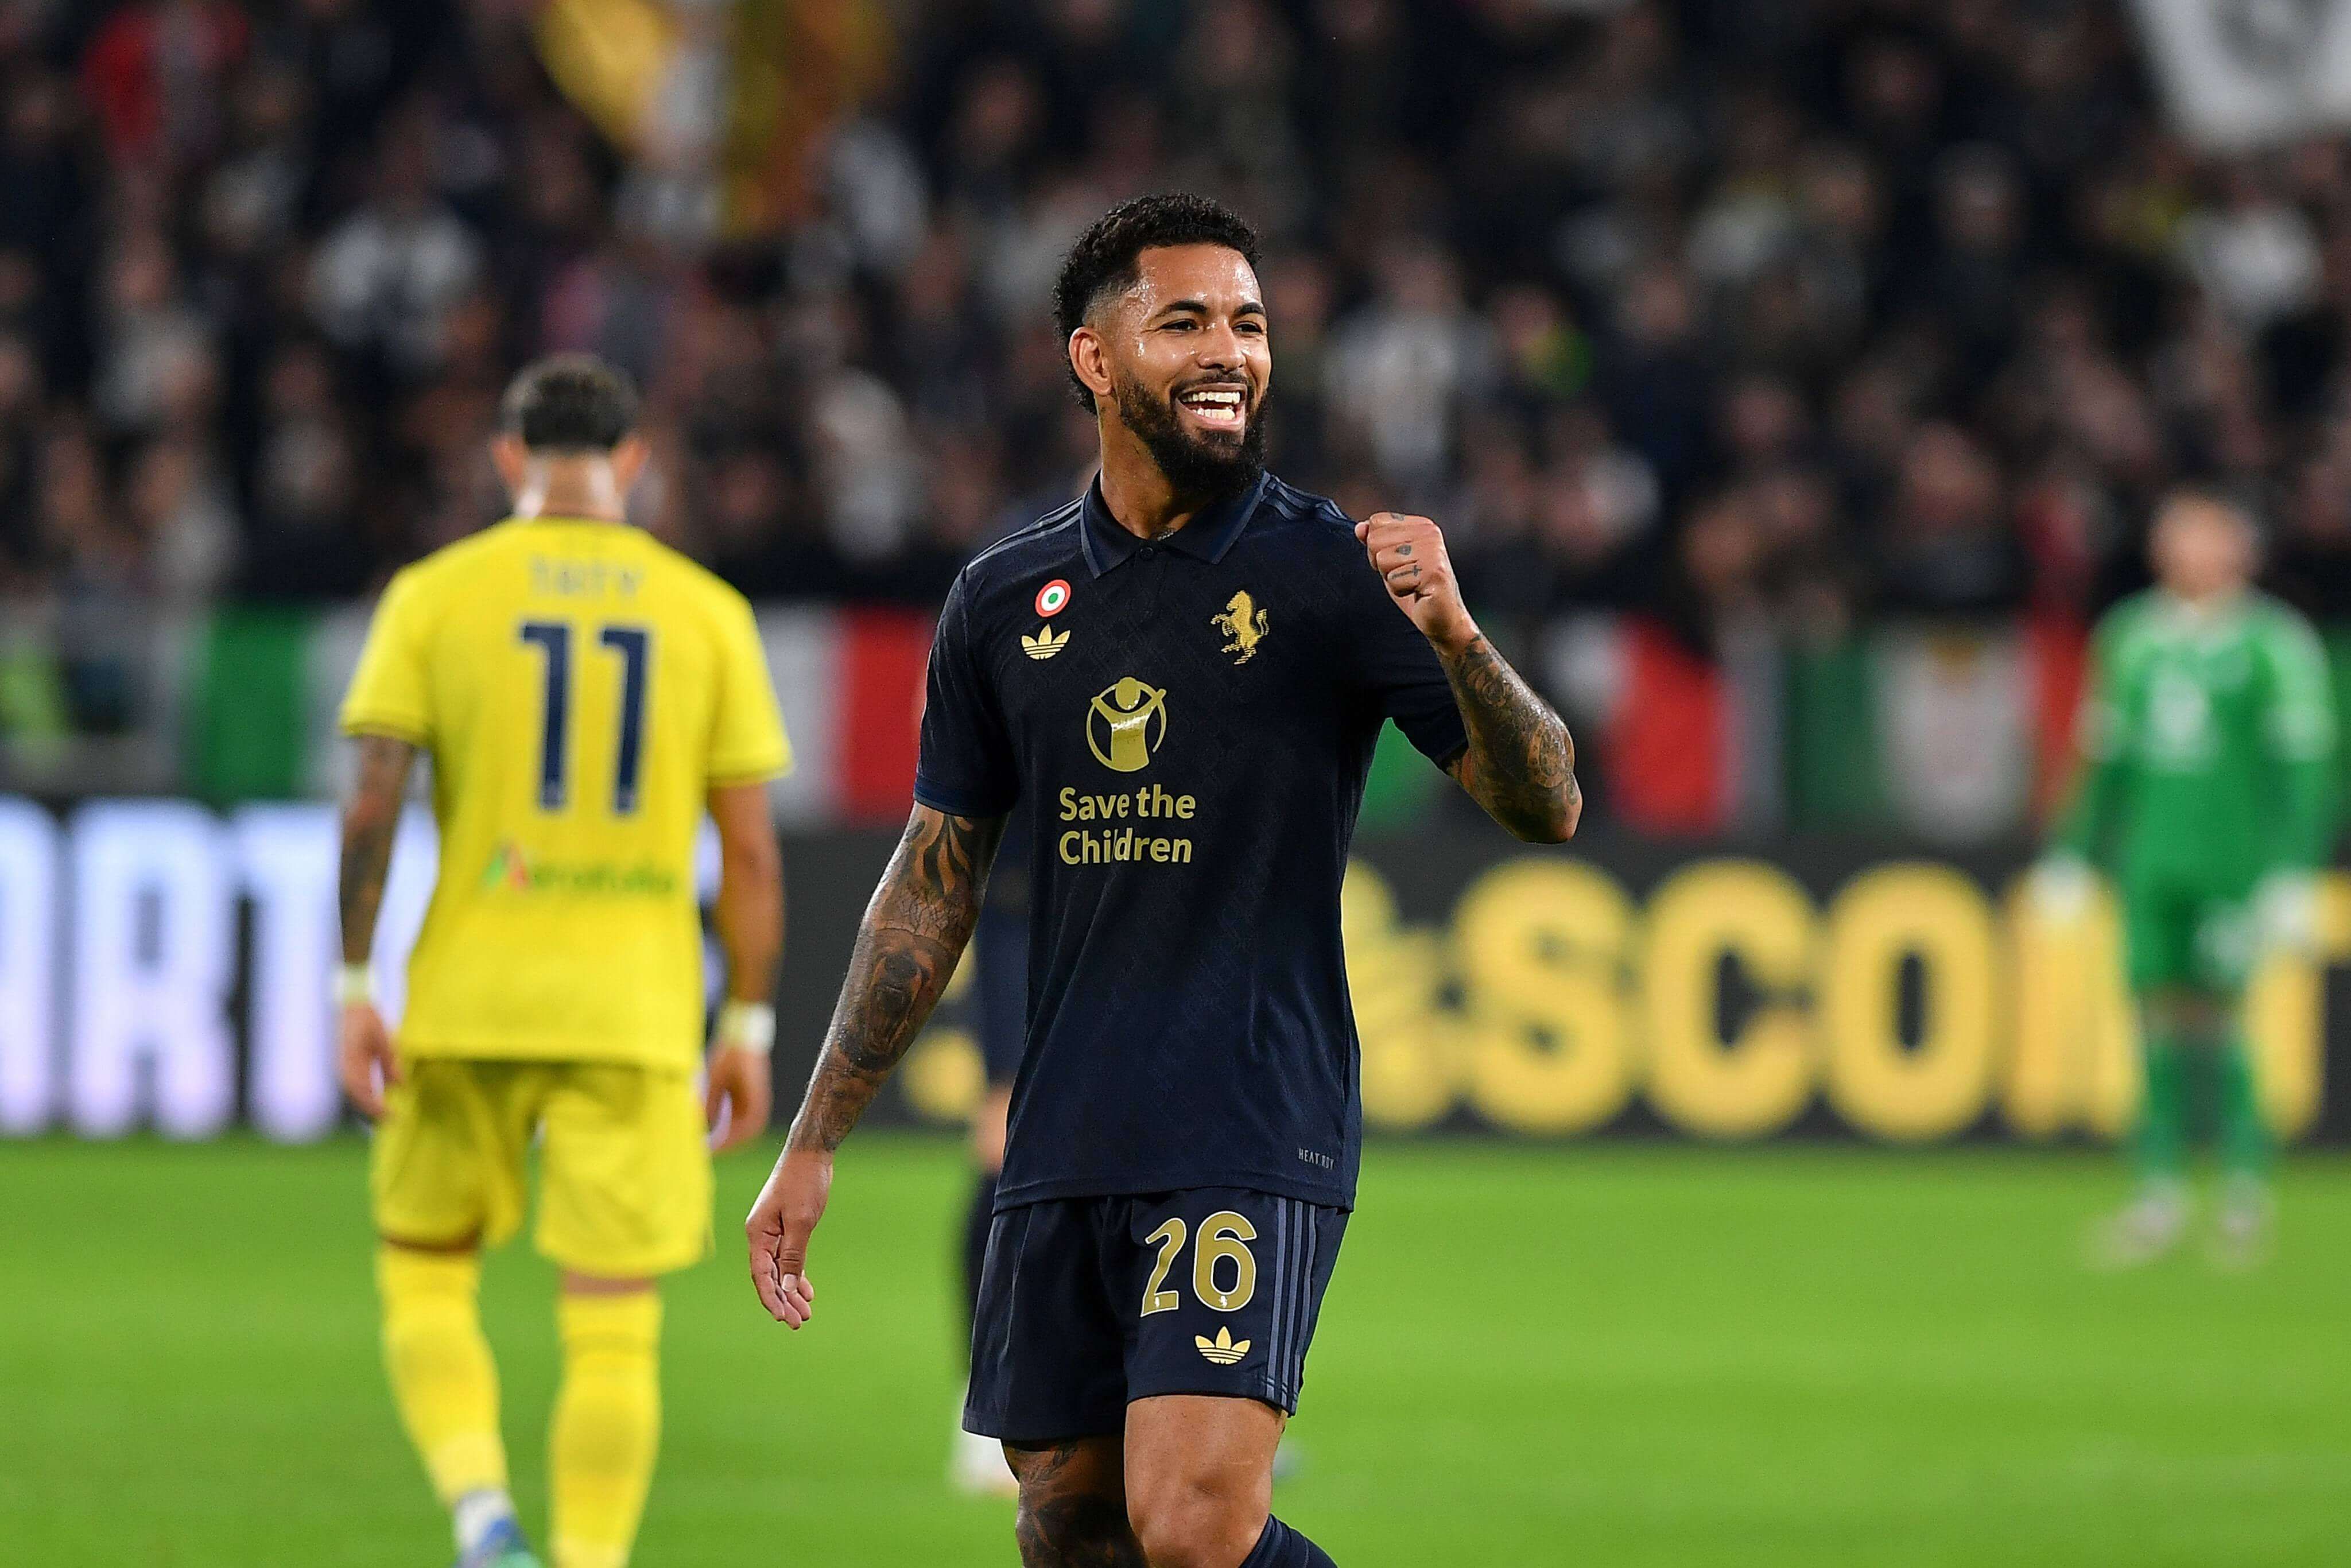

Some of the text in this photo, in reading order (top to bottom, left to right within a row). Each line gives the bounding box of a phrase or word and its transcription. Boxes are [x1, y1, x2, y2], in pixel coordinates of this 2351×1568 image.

[520, 621, 649, 814] 11
[1060, 784, 1196, 821] Save the
[1140, 1210, 1258, 1318] 26
